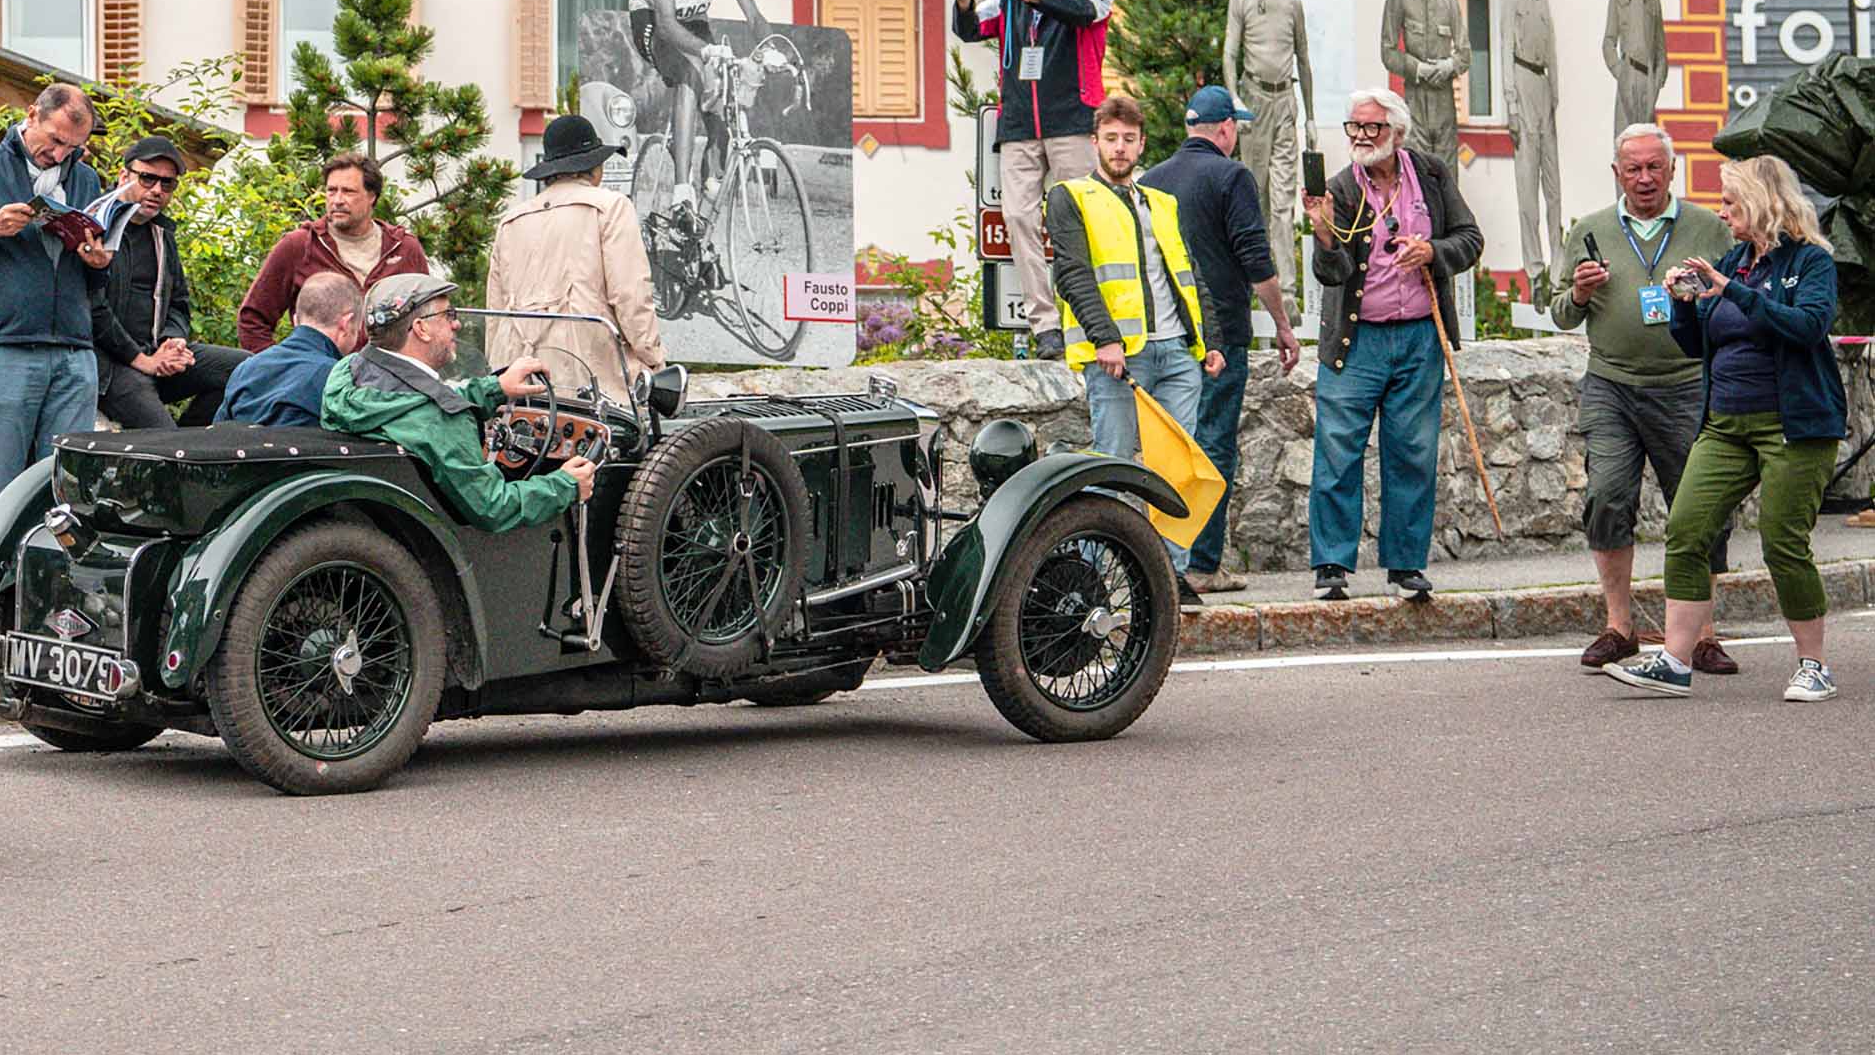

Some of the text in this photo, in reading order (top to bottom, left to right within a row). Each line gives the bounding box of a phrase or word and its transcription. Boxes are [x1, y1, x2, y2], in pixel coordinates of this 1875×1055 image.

[804, 280, 848, 295] Fausto
[810, 297, 848, 314] Coppi
[9, 637, 113, 693] MV 3079
